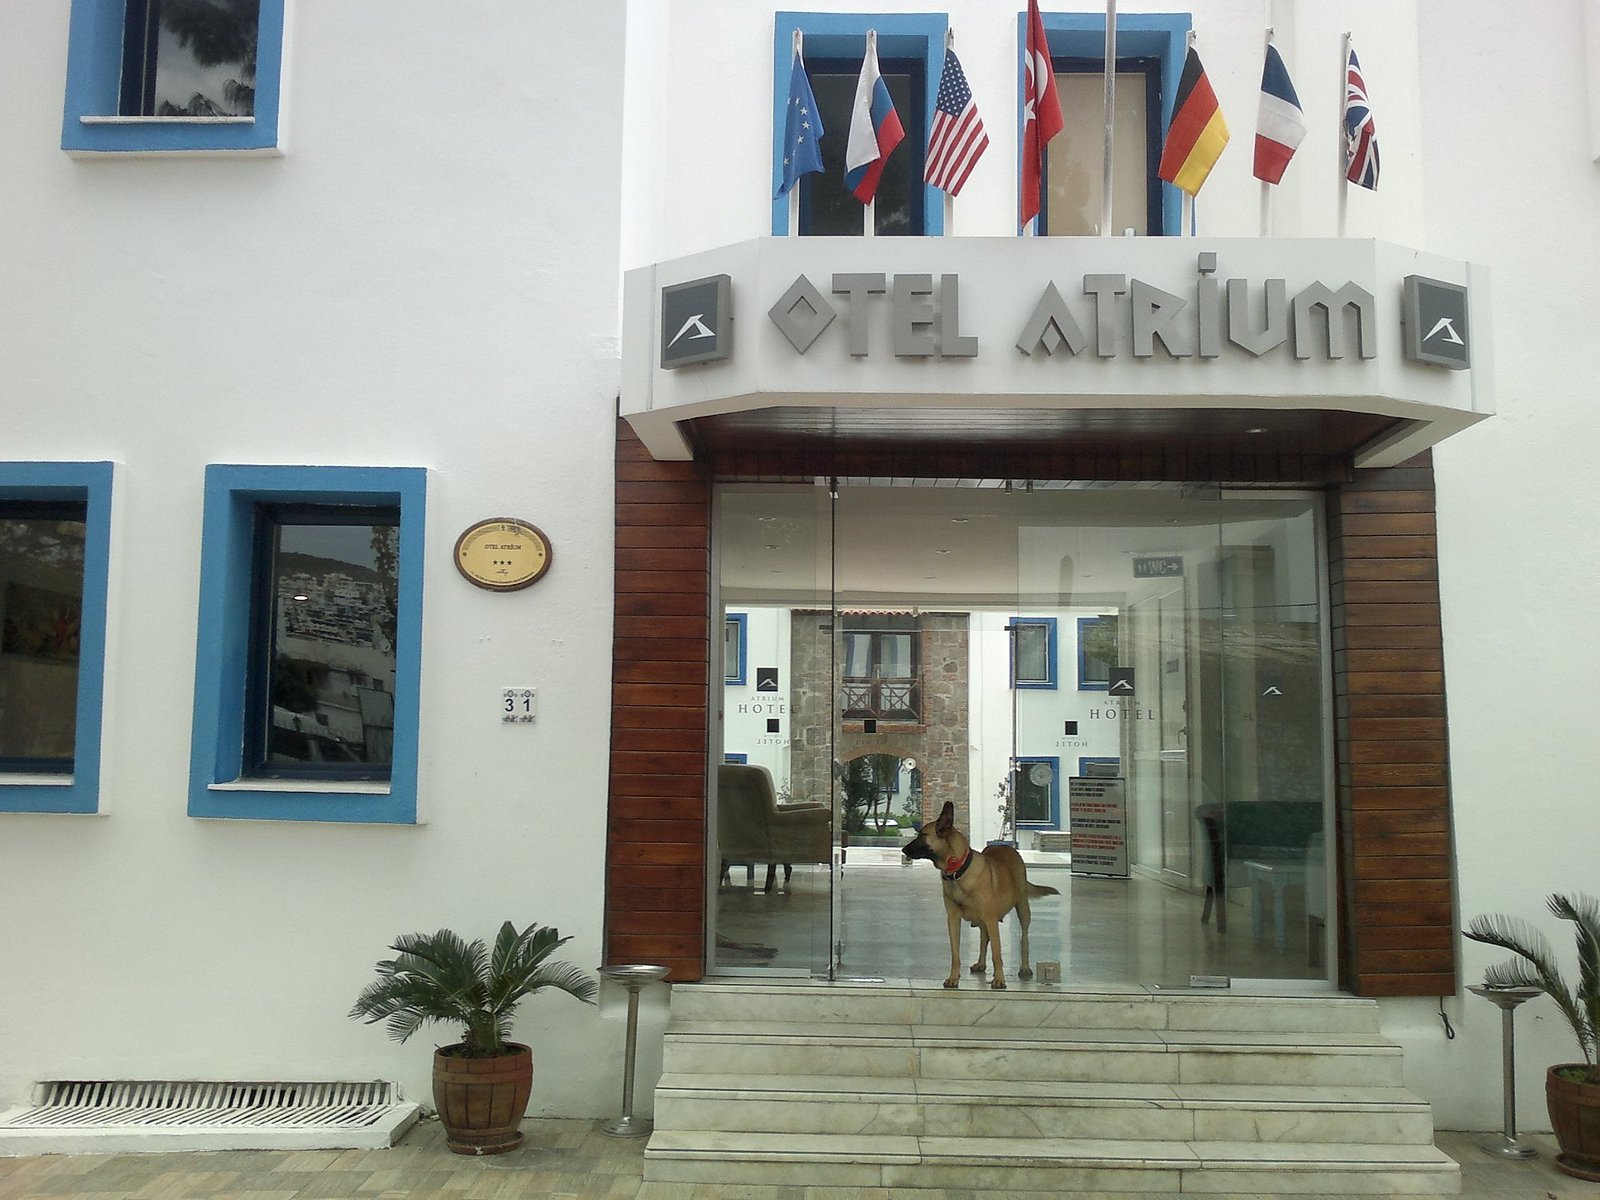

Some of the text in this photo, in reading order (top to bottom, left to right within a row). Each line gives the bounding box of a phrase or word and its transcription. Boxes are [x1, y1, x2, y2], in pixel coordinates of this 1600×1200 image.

[767, 273, 979, 358] OTEL
[738, 704, 798, 714] HOTEL
[1089, 708, 1155, 720] HOTEL
